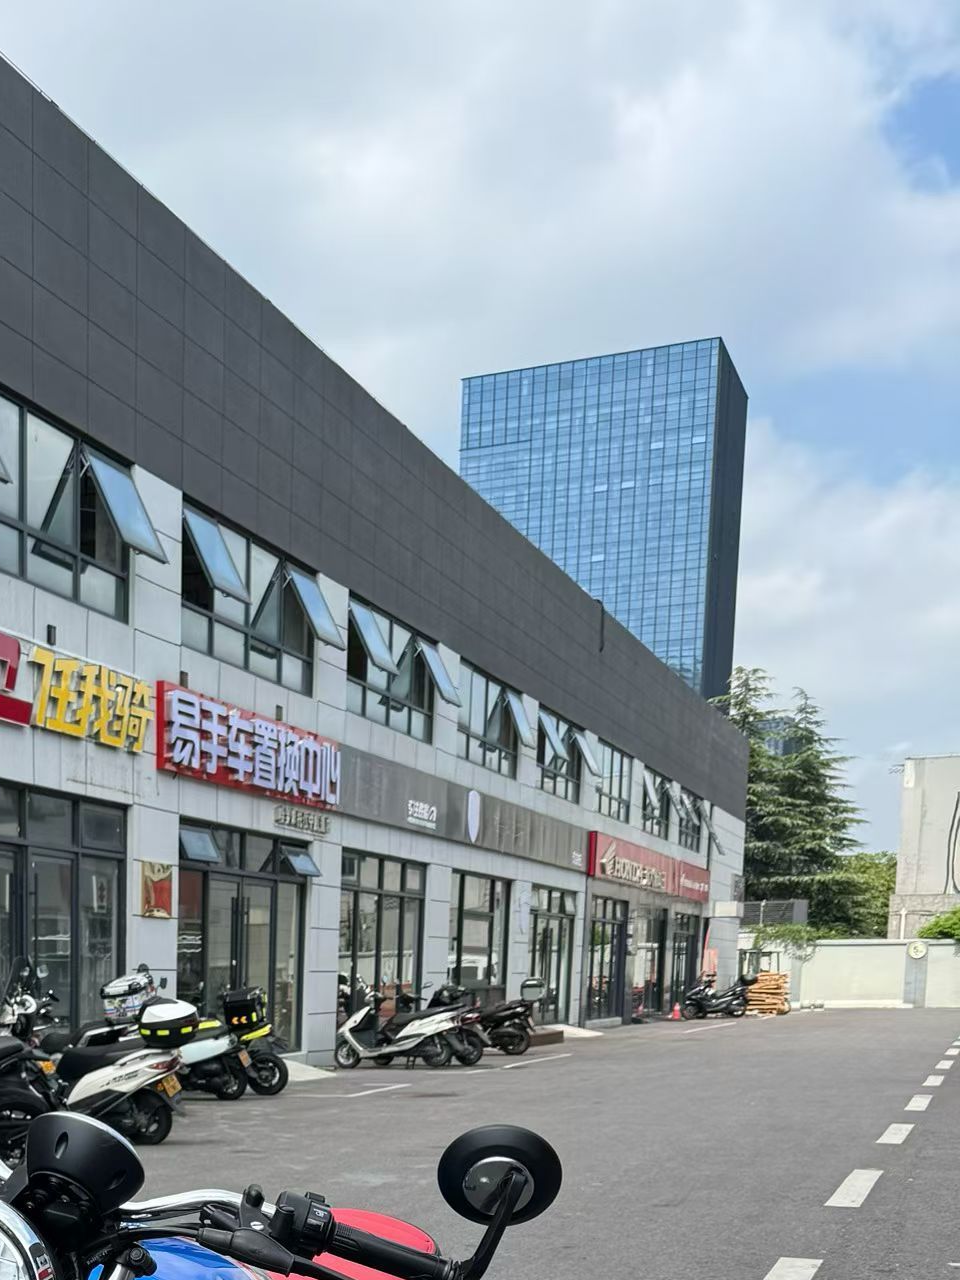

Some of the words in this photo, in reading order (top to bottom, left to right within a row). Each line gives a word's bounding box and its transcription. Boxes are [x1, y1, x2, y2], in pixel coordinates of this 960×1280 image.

[30, 647, 155, 753] 任我骑
[167, 689, 339, 805] 易手车置换中心
